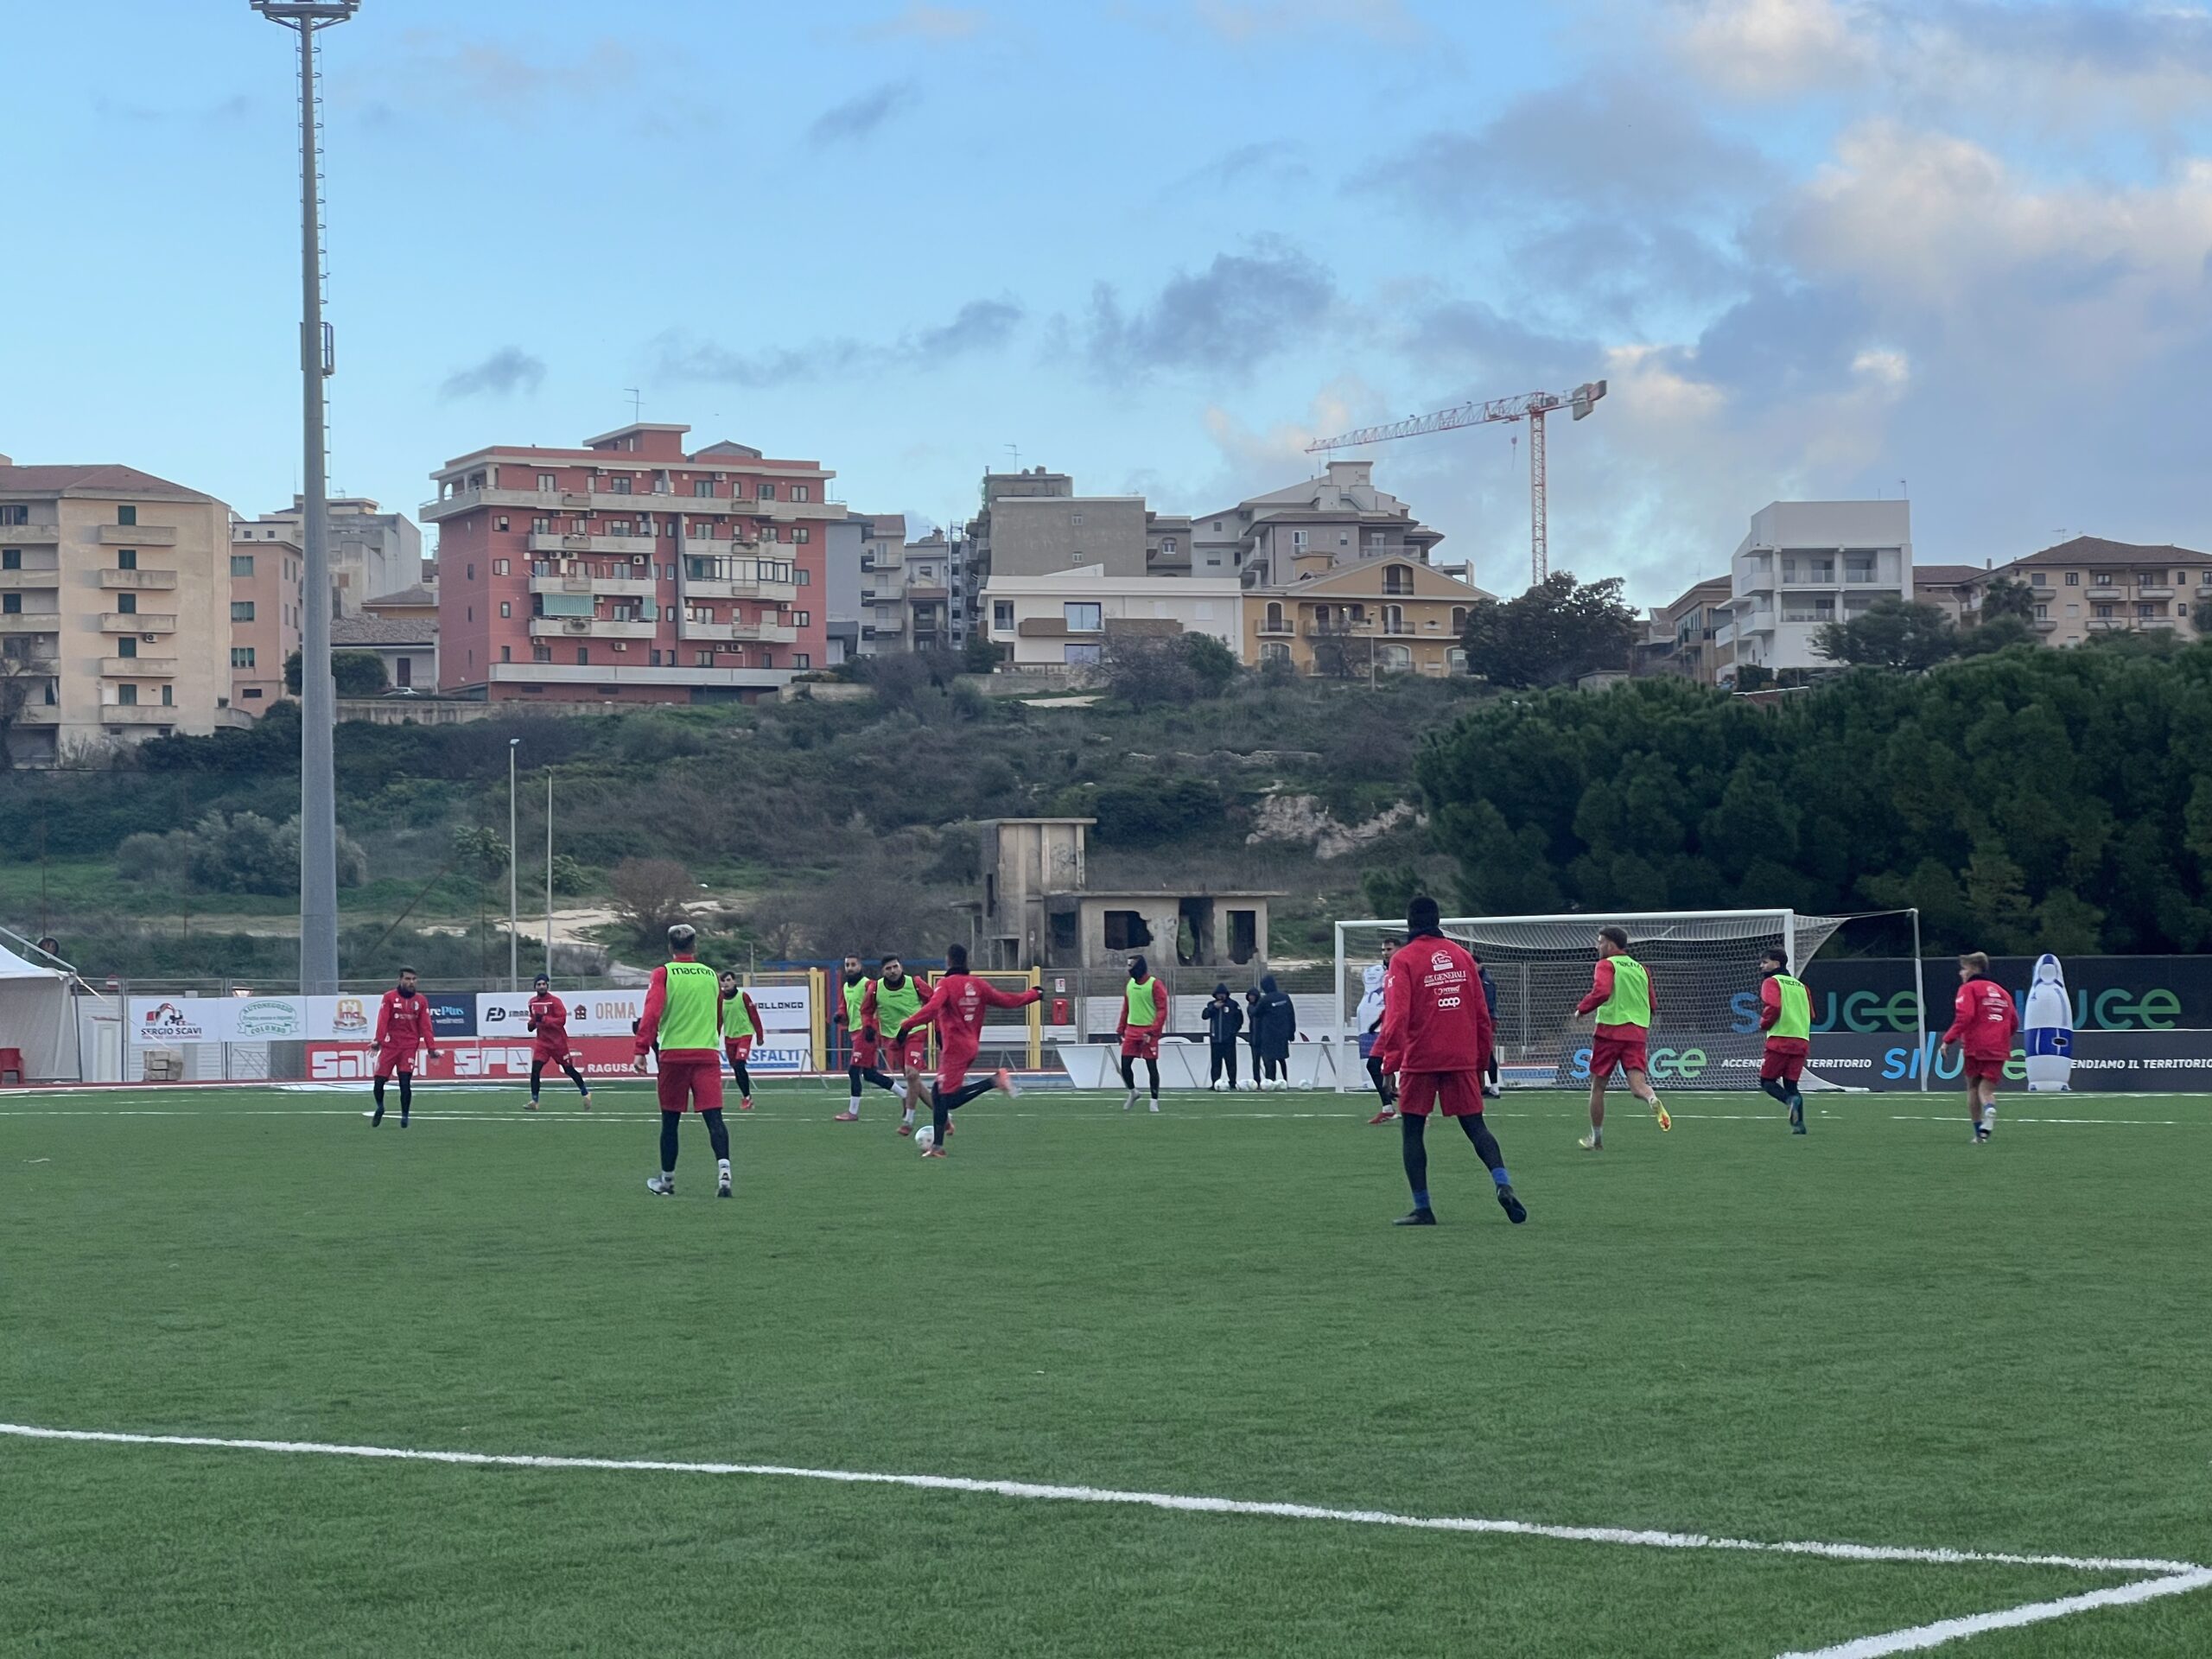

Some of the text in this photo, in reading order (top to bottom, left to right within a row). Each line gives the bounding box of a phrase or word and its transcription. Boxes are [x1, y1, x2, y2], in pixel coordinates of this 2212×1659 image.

[671, 967, 715, 976] macron
[1434, 970, 1466, 981] GENERALI
[1438, 997, 1460, 1007] coop
[141, 1027, 203, 1036] SERGIO SCAVI
[747, 1049, 799, 1062] SFALTI
[588, 1064, 638, 1073] RAGUSA
[1721, 1058, 1765, 1068] ACCEND
[1806, 1058, 1872, 1069] TERRITORIO
[2070, 1058, 2126, 1070] ENDIAMO
[2127, 1059, 2139, 1070] IL
